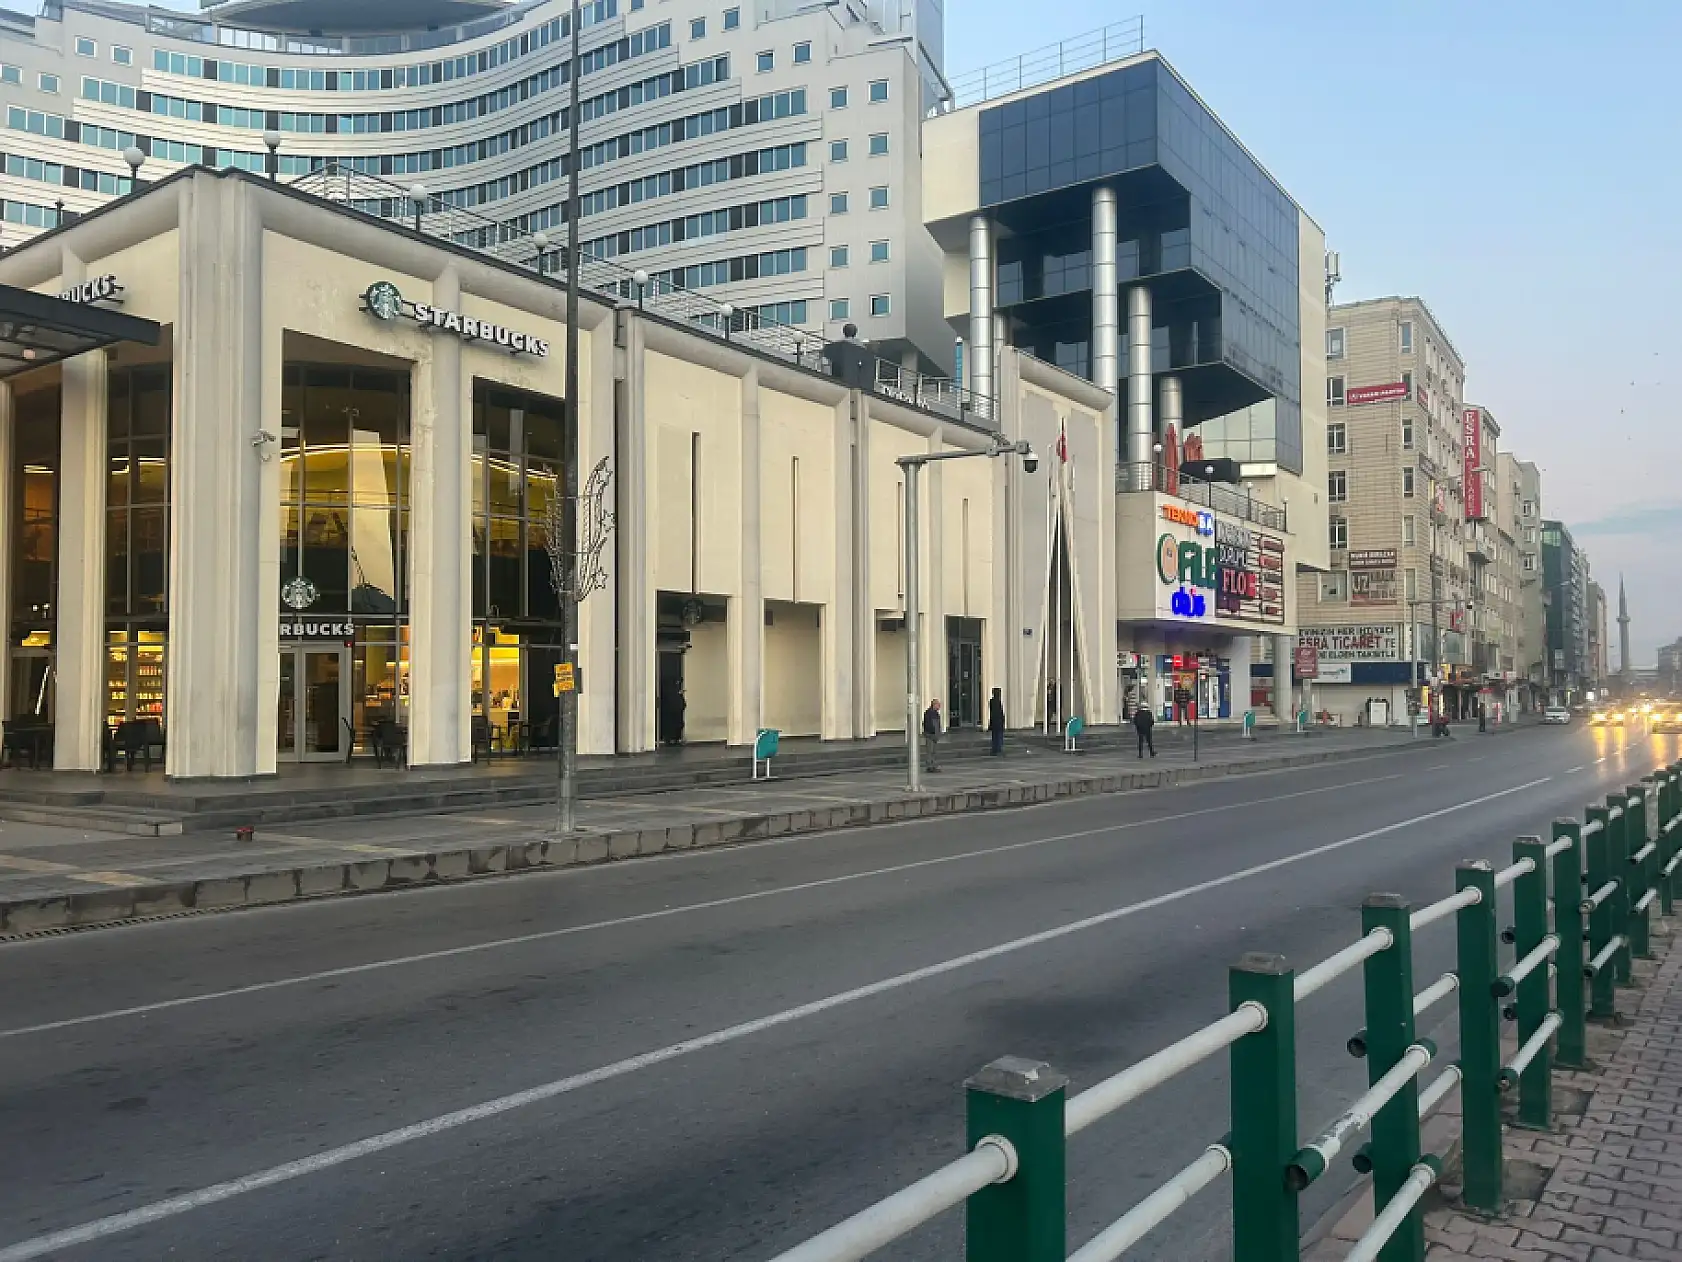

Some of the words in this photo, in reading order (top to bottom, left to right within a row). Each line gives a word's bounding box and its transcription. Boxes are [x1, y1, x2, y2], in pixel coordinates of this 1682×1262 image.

[414, 302, 550, 358] STARBUCKS
[1464, 411, 1476, 459] ESRA
[1223, 568, 1247, 595] FLO
[1299, 637, 1329, 649] ESRA
